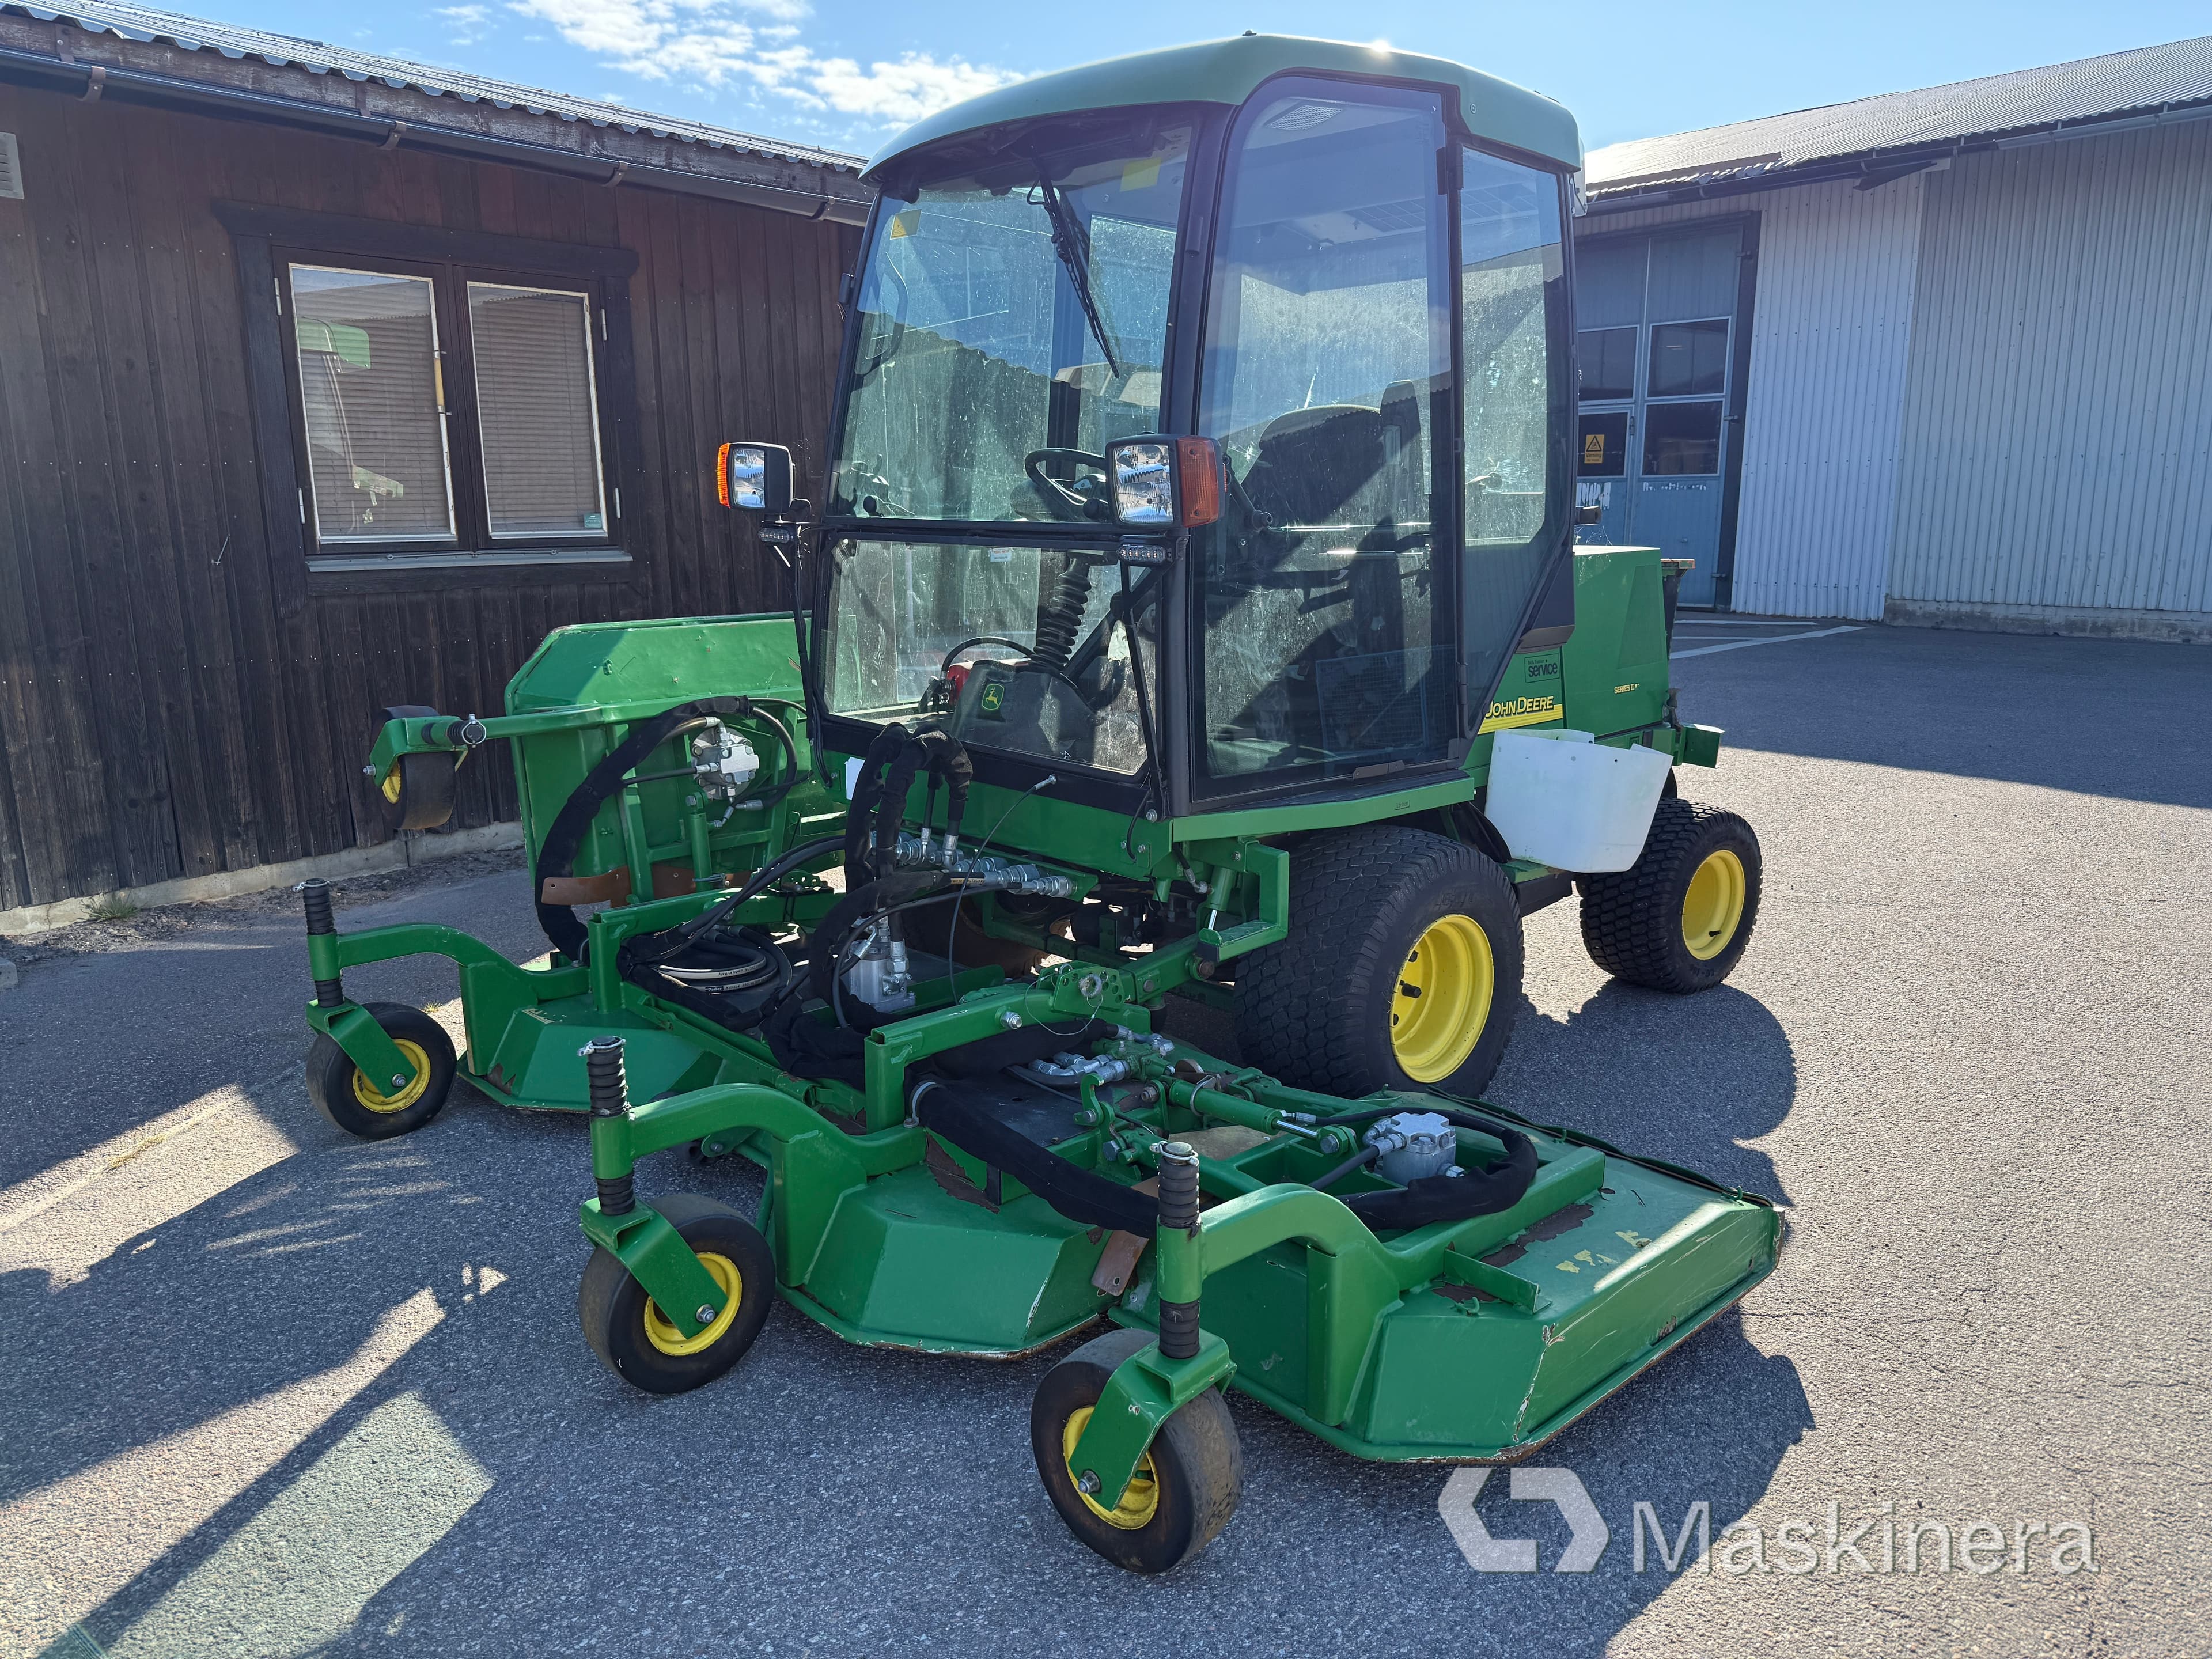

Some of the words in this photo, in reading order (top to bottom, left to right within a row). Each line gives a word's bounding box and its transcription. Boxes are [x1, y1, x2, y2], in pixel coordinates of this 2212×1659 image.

[1528, 659, 1558, 677] service
[1614, 684, 1630, 694] SERIES
[1485, 699, 1517, 718] JOHN
[1516, 696, 1554, 714] DEERE
